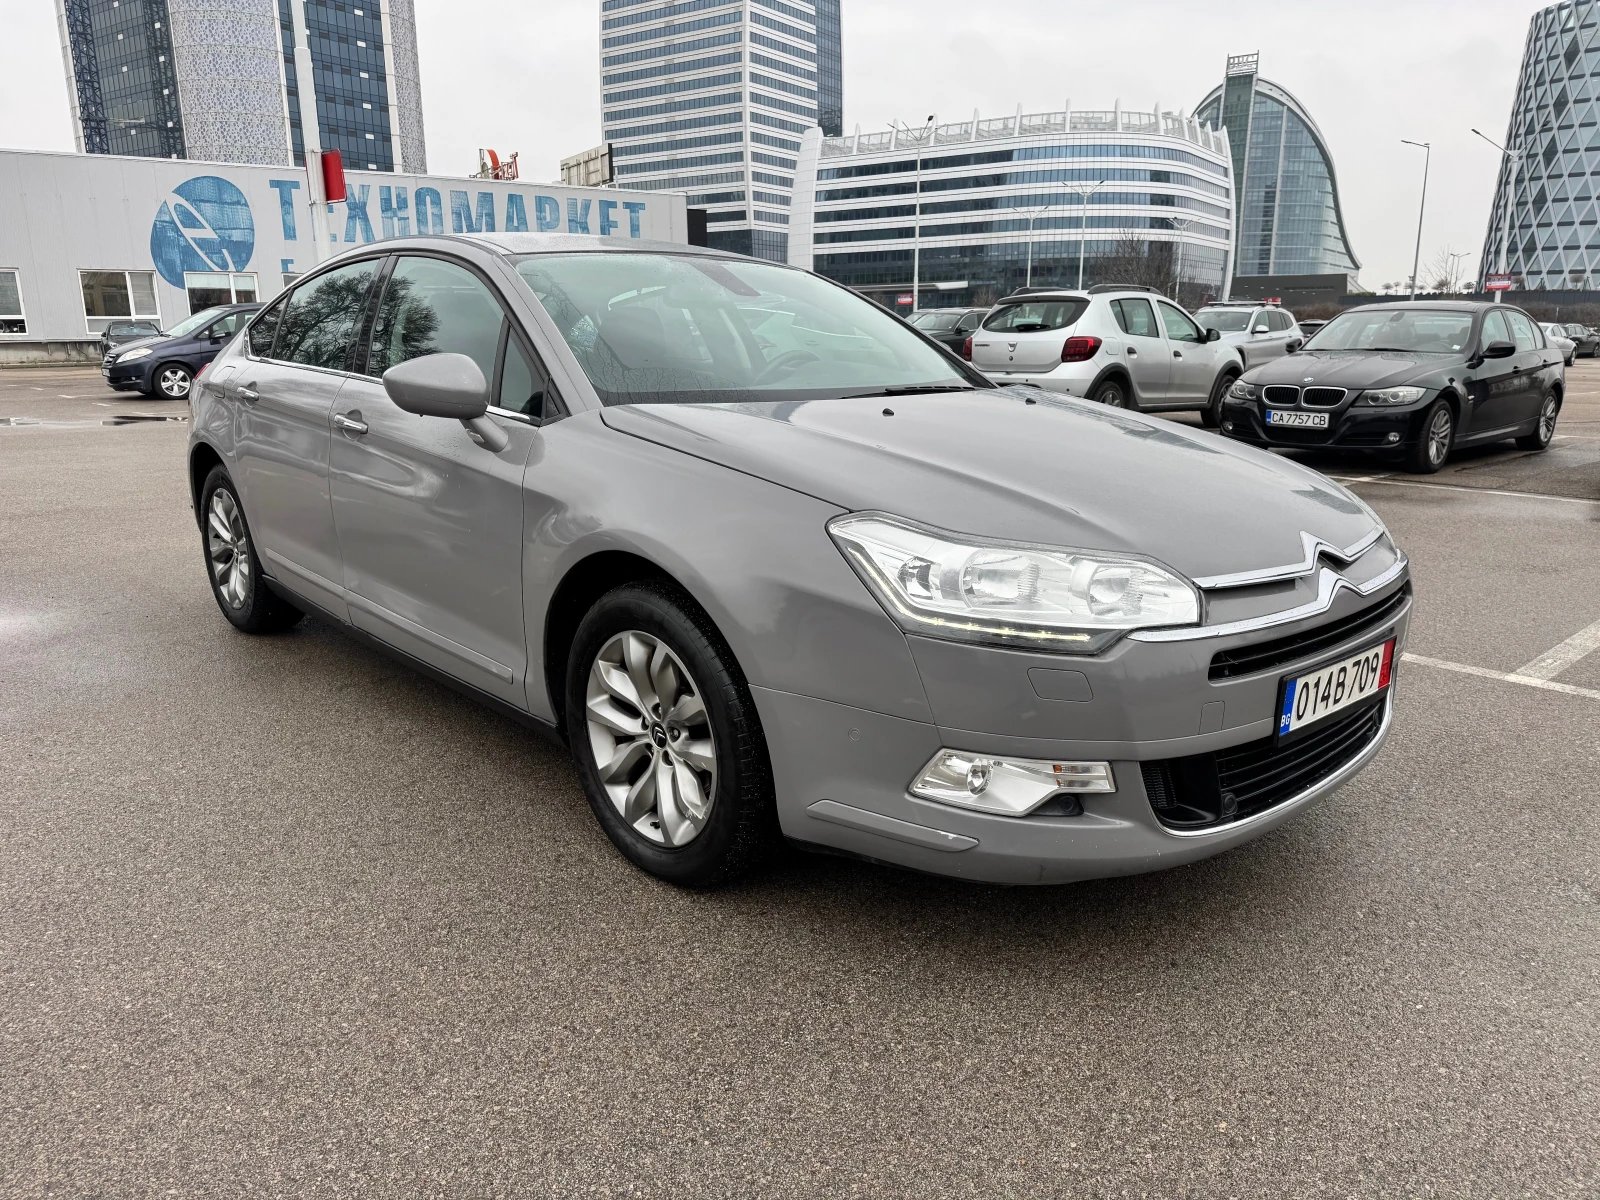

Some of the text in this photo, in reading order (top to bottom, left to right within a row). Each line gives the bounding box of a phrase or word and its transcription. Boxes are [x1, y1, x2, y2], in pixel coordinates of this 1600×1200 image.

[1272, 412, 1284, 423] CA
[1286, 413, 1311, 425] 7757
[1312, 415, 1326, 426] CB
[1280, 713, 1291, 728] BG
